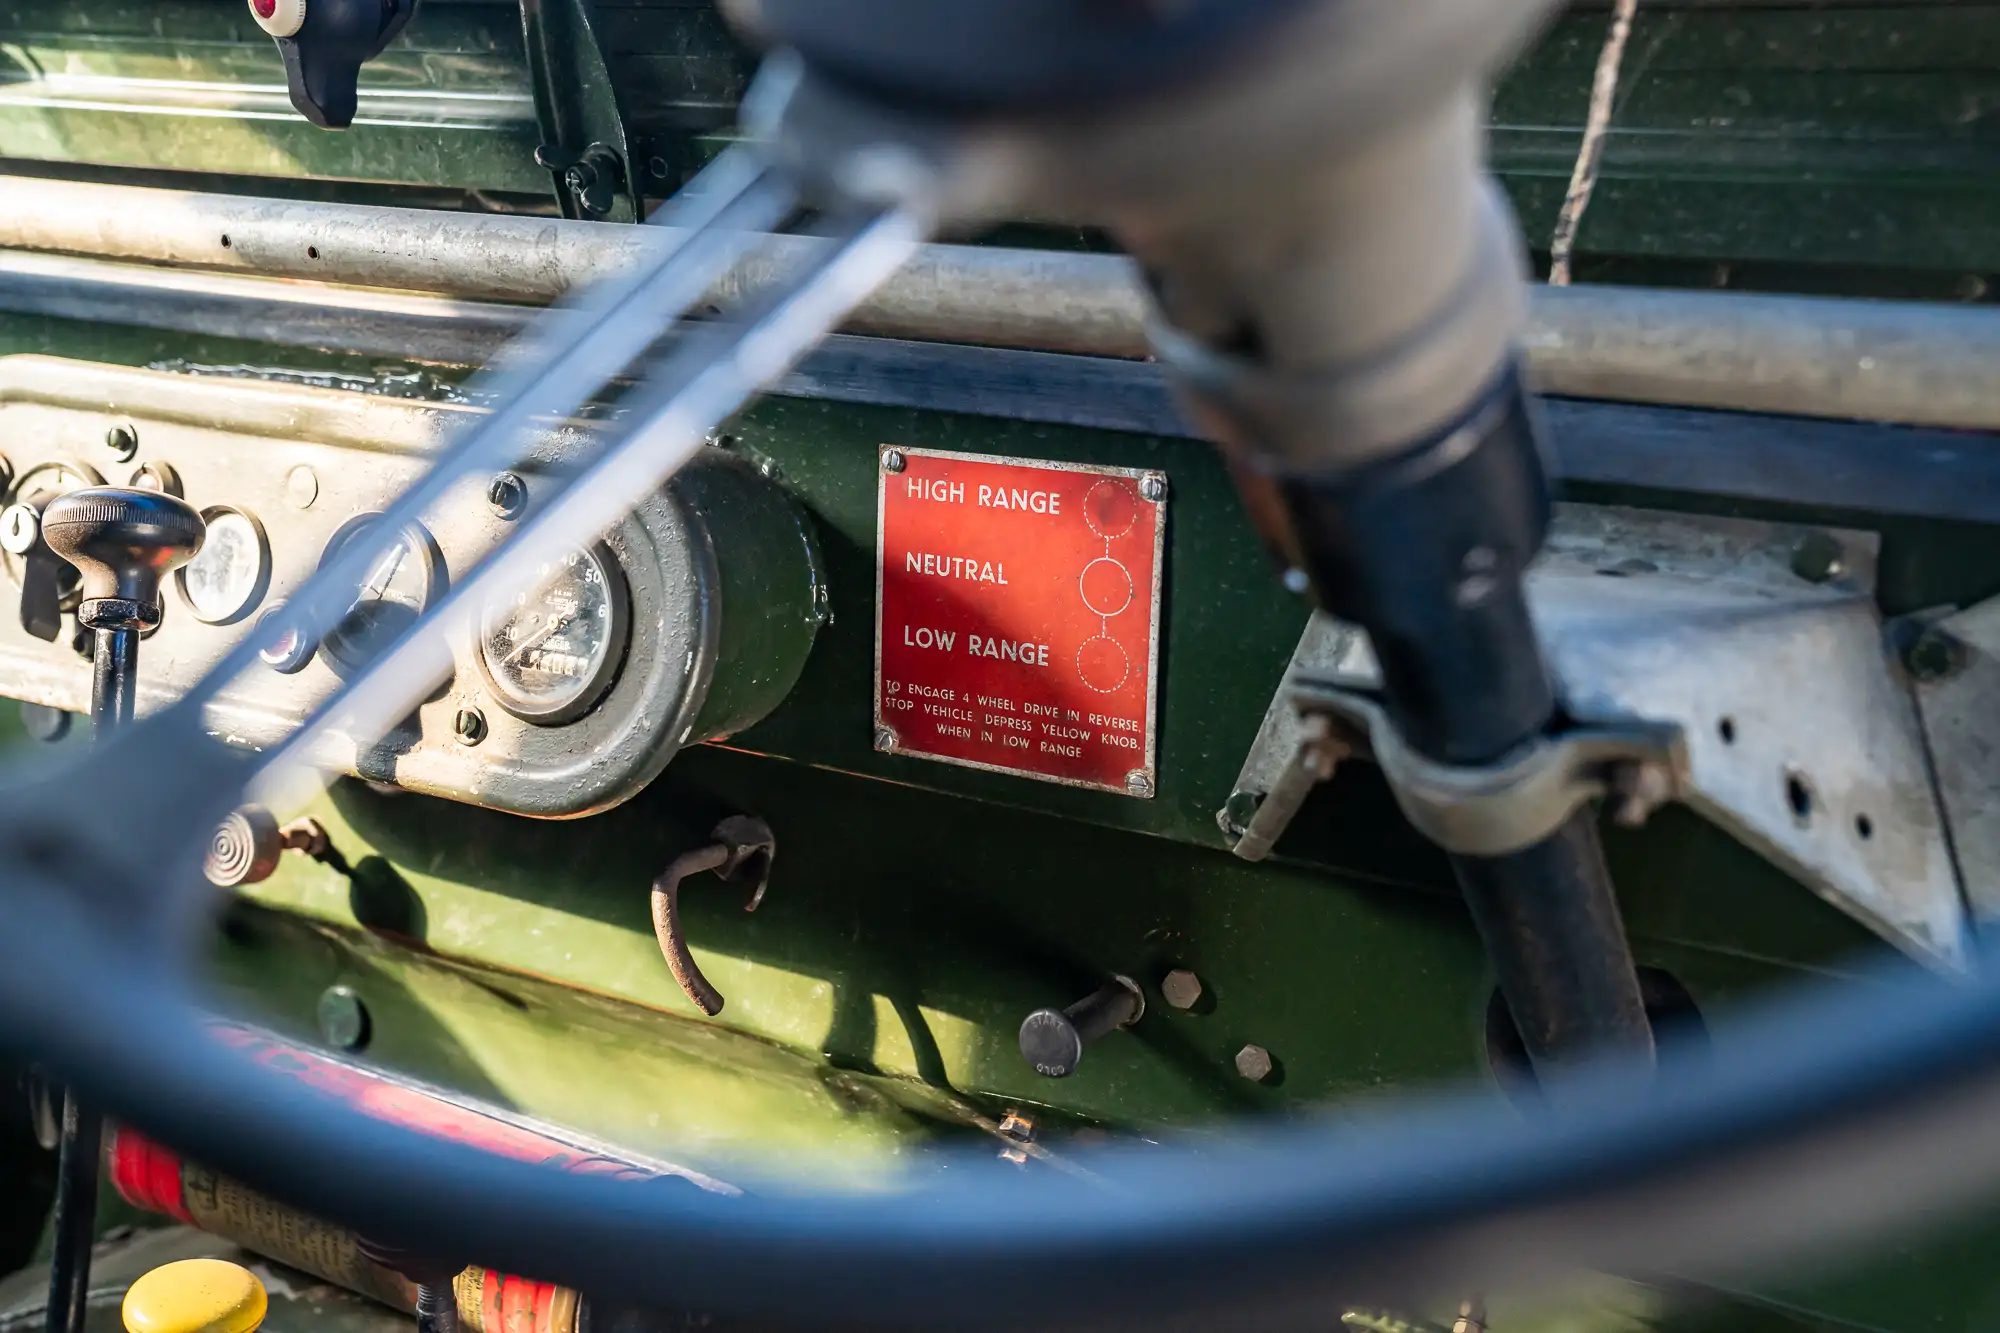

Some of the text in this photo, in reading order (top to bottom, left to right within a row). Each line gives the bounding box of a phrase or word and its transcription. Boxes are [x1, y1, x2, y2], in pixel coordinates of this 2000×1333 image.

[907, 476, 1061, 515] HIGH RANGE
[585, 568, 601, 583] 50
[905, 551, 1008, 585] NEUTRAL
[904, 625, 1049, 667] LOW RANGE
[885, 679, 901, 692] TO
[908, 683, 955, 701] ENGAGE
[963, 692, 970, 703] 4
[977, 694, 1016, 712] WHEEL
[1024, 702, 1059, 719] DRIVE
[1067, 709, 1080, 722] IN
[885, 697, 914, 711] STOP
[985, 714, 1032, 732] DEPRESS
[1041, 722, 1091, 741] YELLOW
[936, 723, 1082, 758] WHEN IN LOW RANGE
